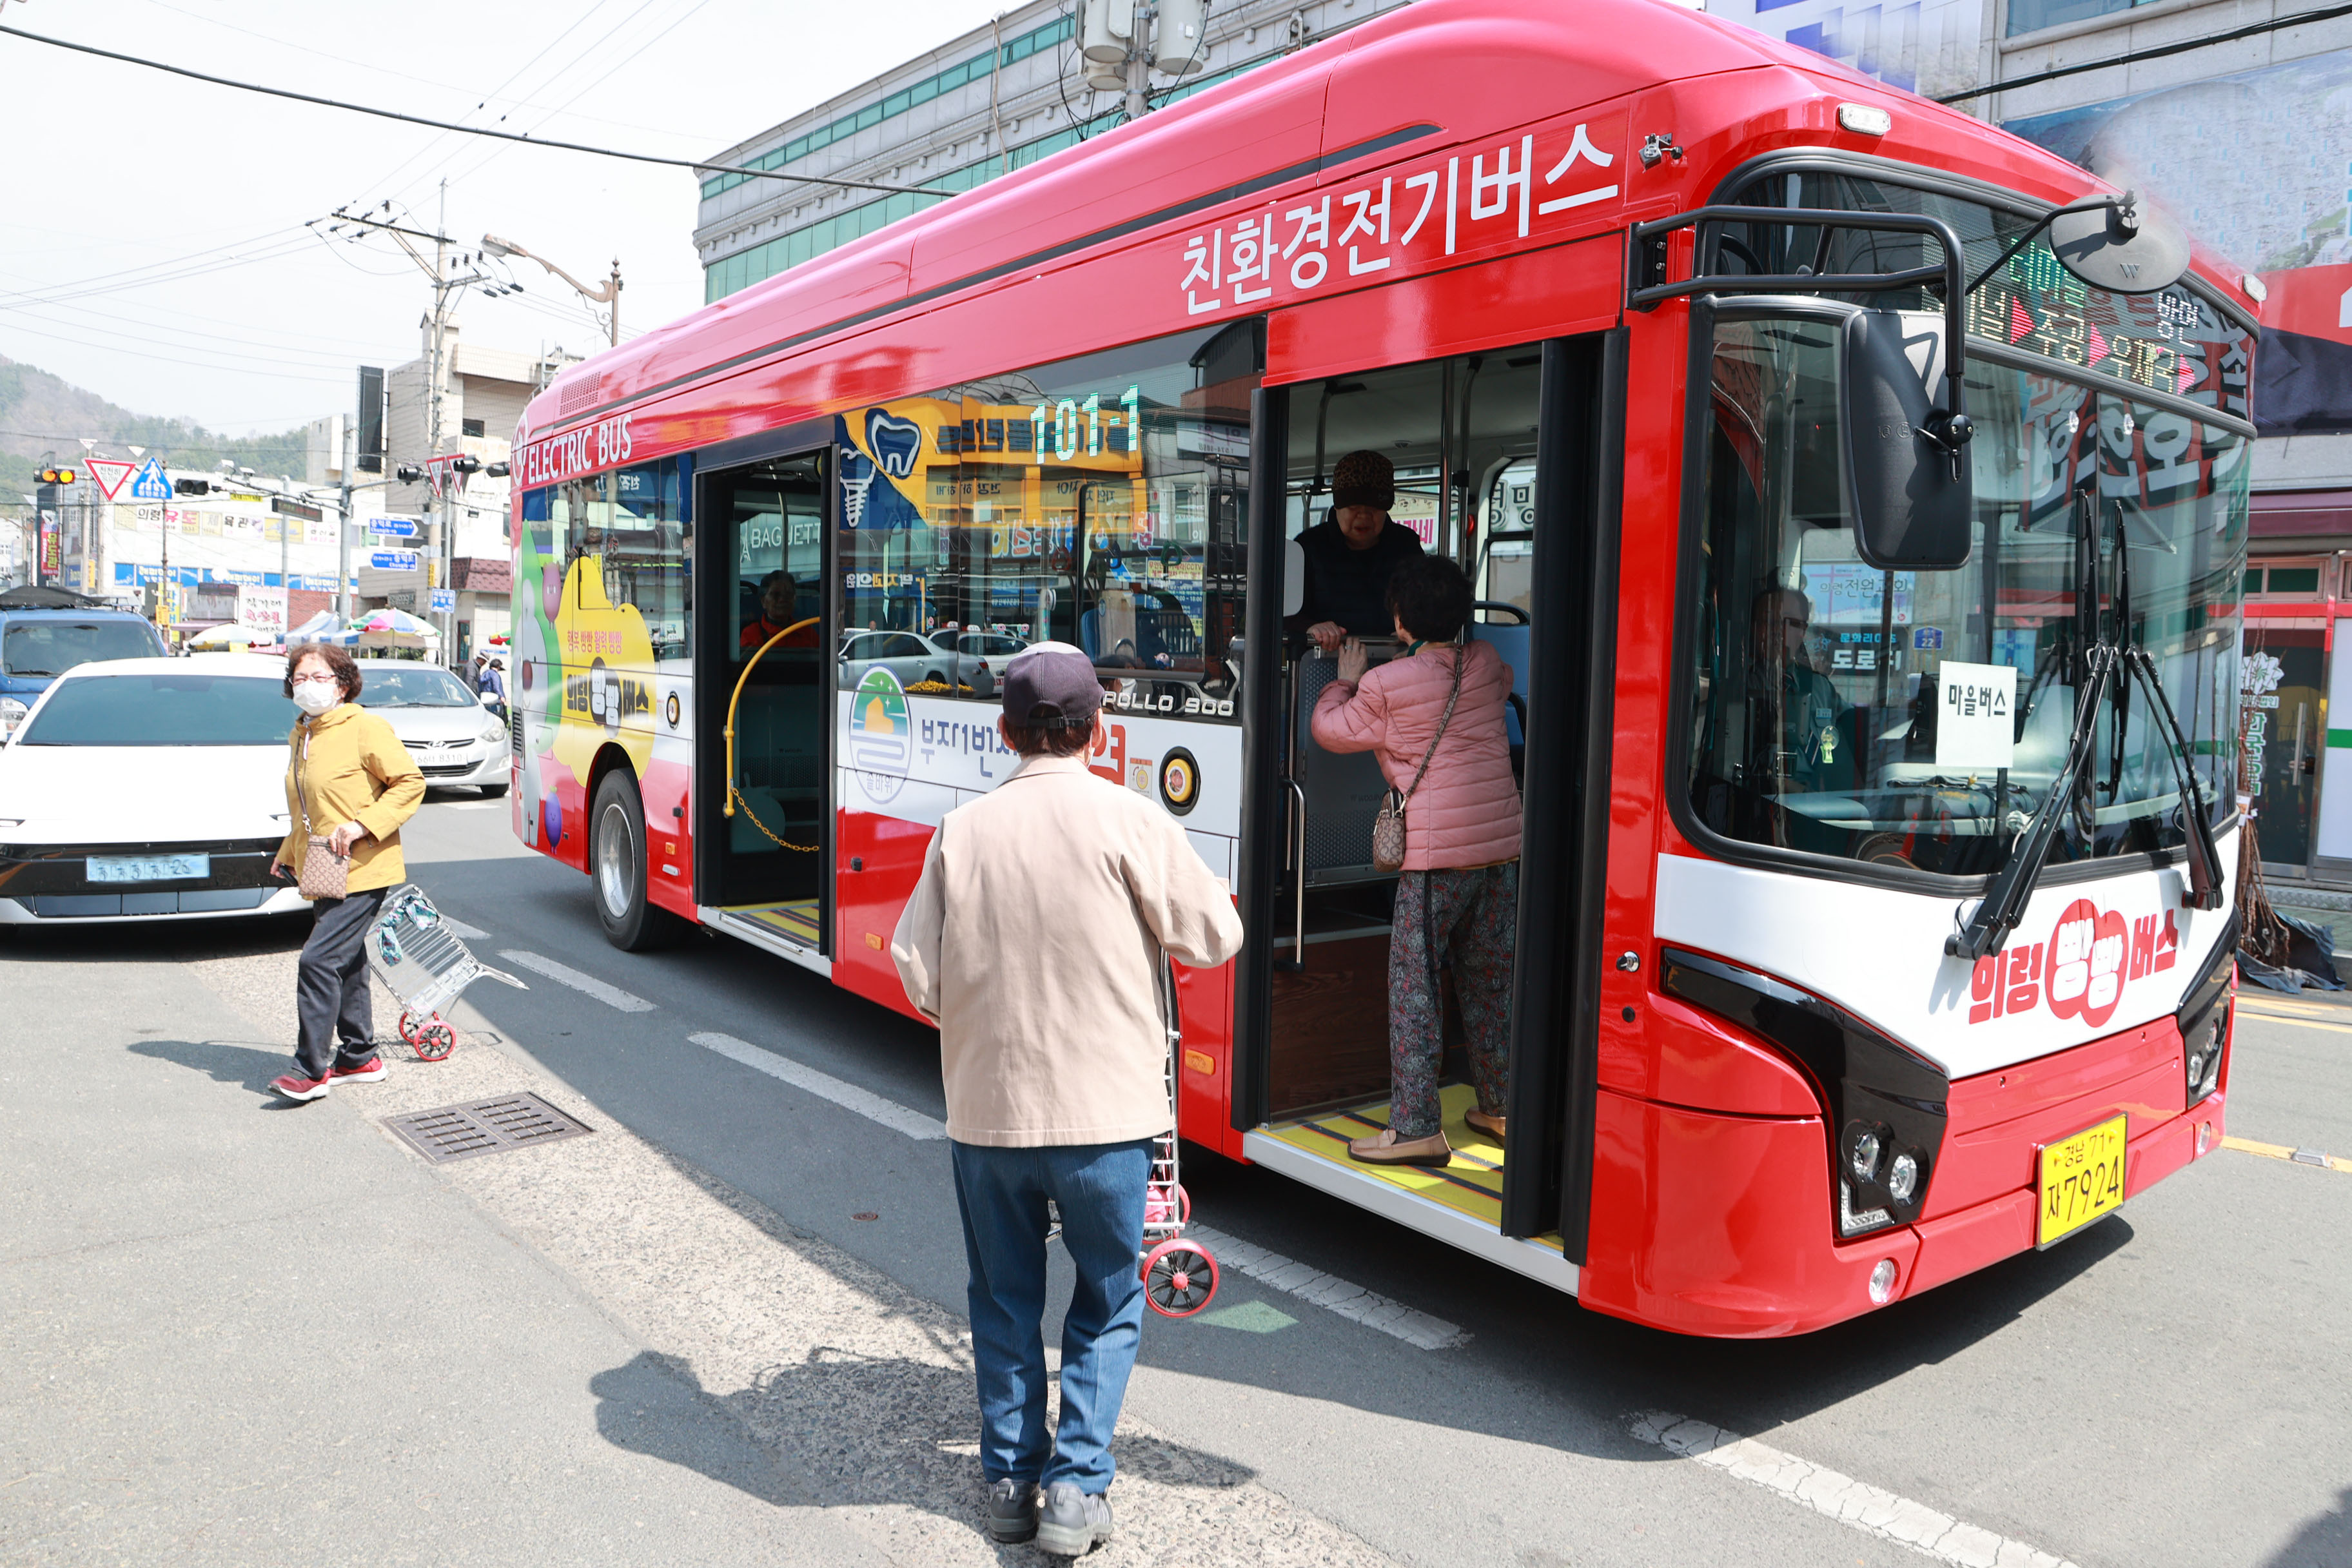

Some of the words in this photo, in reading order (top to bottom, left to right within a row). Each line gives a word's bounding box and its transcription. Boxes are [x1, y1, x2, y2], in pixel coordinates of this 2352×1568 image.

[1181, 123, 1618, 315] 친환경전기버스
[1030, 384, 1140, 464] 101-1
[528, 427, 593, 484] ELECTRIC
[598, 413, 632, 467] BUS
[567, 630, 580, 653] 행복
[581, 631, 593, 653] 빵빵
[594, 630, 607, 654] 활력
[609, 631, 622, 654] 빵빵
[1921, 638, 1934, 647] 22
[567, 674, 588, 712] 의령
[623, 679, 649, 722] 버스
[1184, 697, 1234, 716] 900
[1948, 682, 2007, 720] 마을버스
[1968, 942, 2044, 1024] 의령
[2129, 908, 2179, 981] 버스
[2064, 1139, 2085, 1168] 경남
[2088, 1131, 2106, 1157] 71
[2046, 1155, 2120, 1222] 자7924
